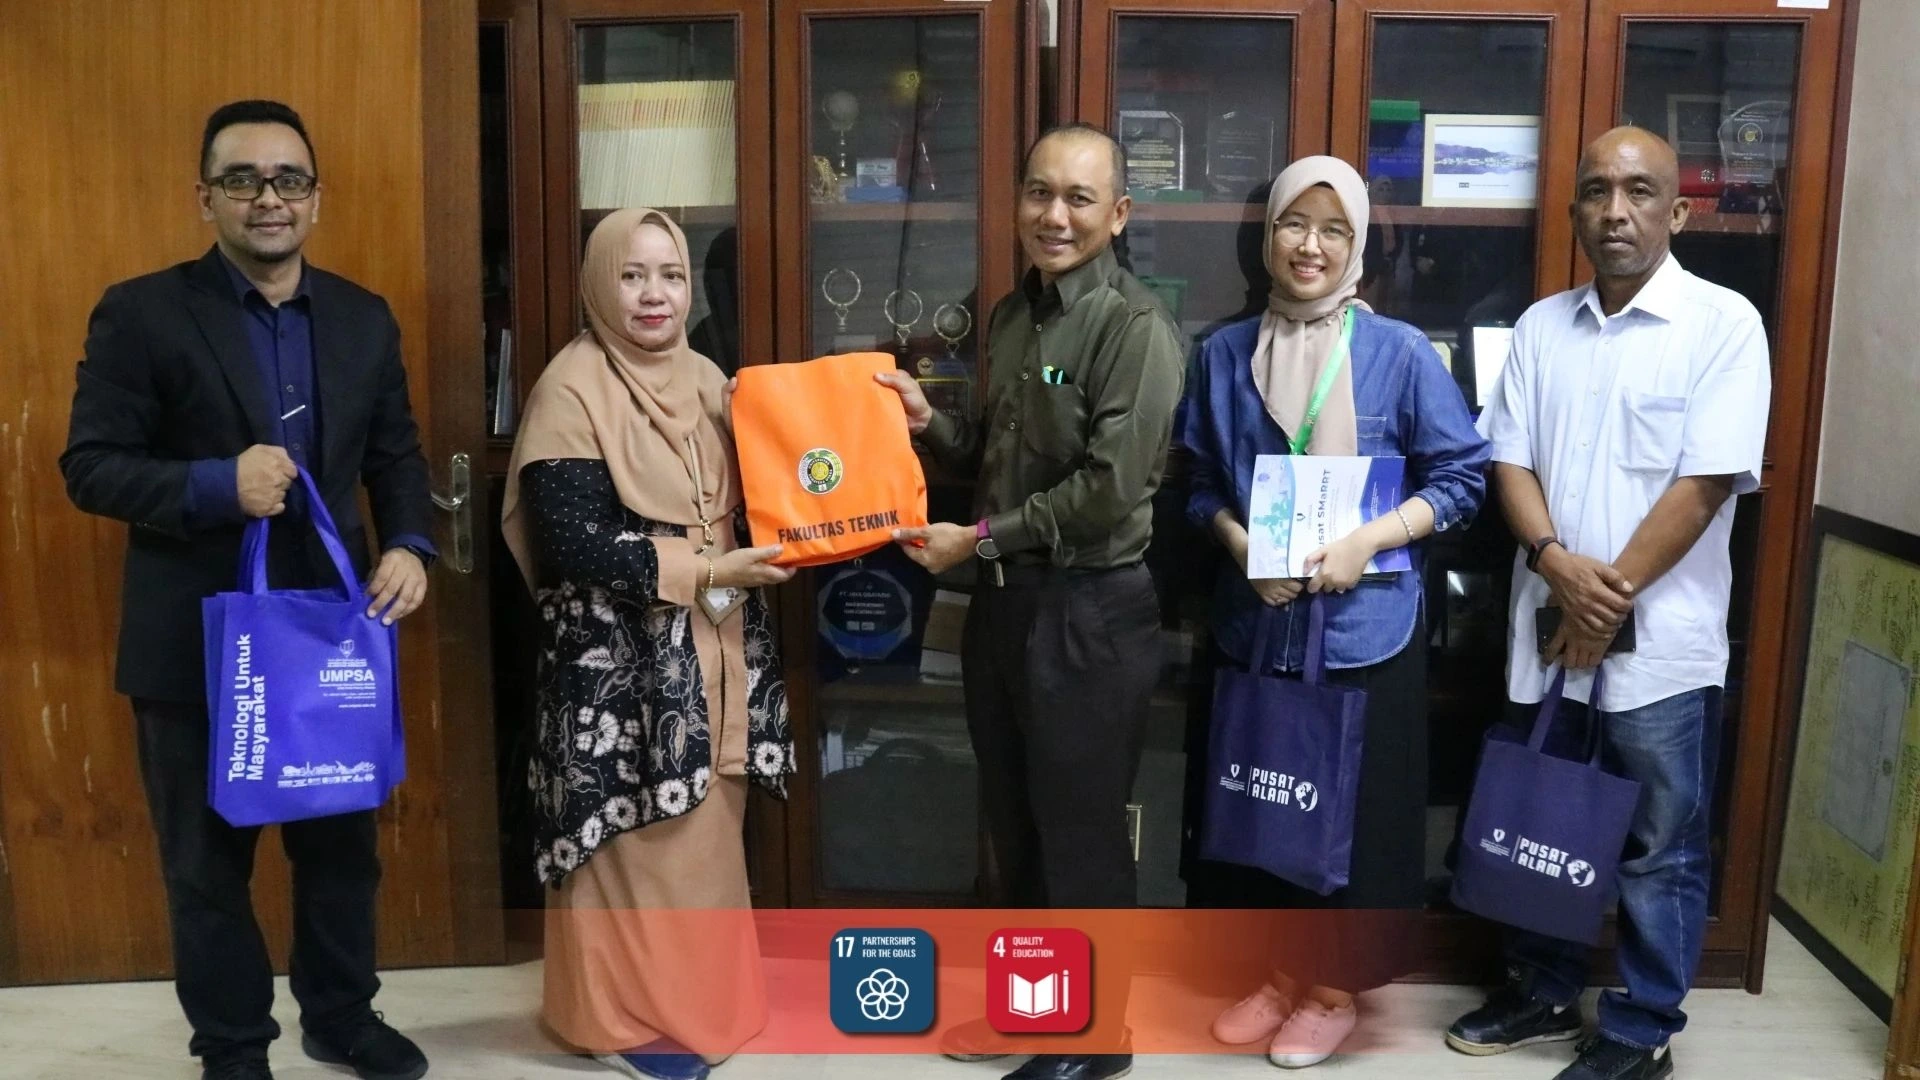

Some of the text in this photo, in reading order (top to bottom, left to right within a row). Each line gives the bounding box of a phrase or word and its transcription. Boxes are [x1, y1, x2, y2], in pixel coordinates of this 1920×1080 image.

[778, 510, 900, 543] FAKULTAS TEKNIK
[319, 669, 375, 682] UMPSA
[228, 633, 253, 782] Teknologi Untuk
[246, 675, 270, 781] Masyarakat
[1252, 767, 1296, 790] PUSAT
[1251, 784, 1290, 806] ALAM
[1520, 837, 1570, 865] PUSAT
[1518, 852, 1562, 878] ALAM
